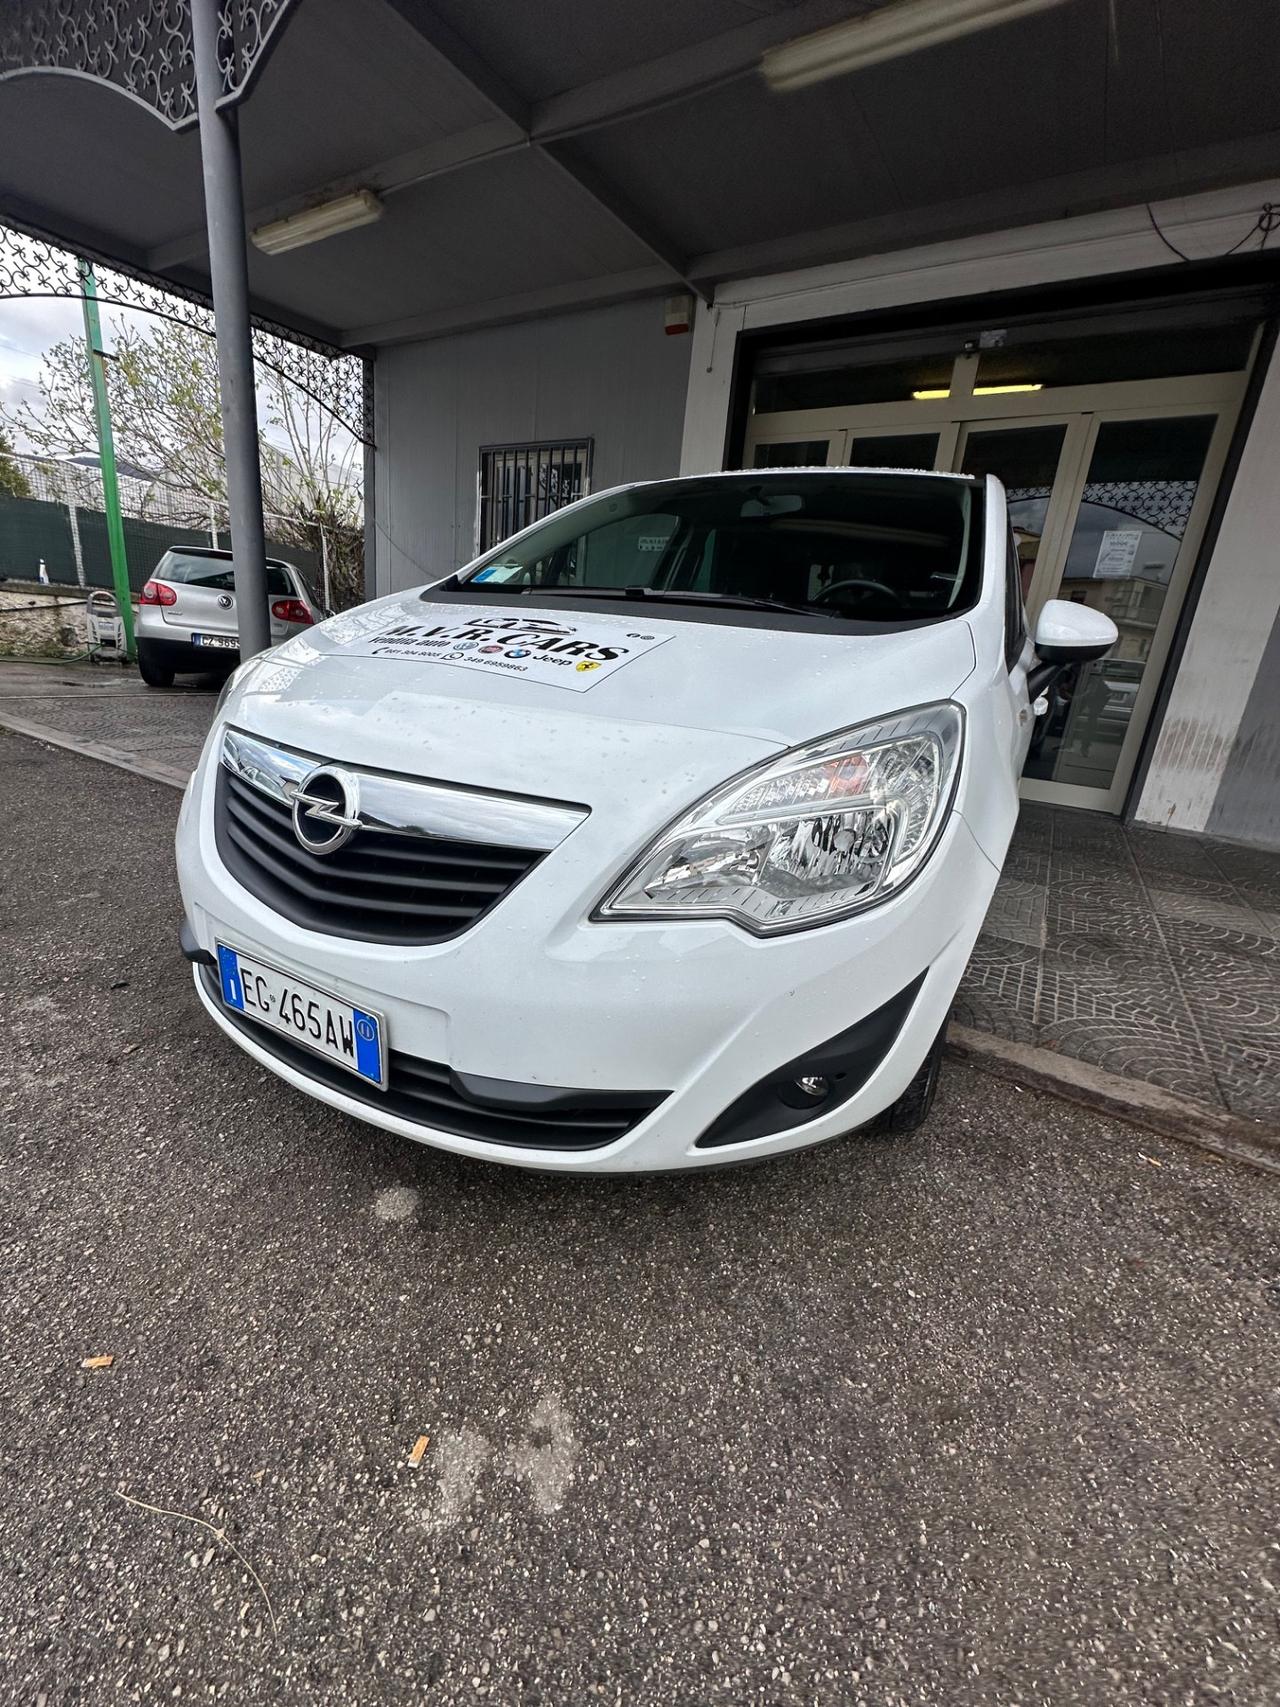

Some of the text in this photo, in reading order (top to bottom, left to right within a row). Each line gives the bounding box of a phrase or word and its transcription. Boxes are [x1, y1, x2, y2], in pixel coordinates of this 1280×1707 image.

[415, 639, 451, 647] auto
[497, 633, 630, 660] CARS
[532, 654, 573, 666] Jeep
[240, 968, 355, 1057] EG 465AW
